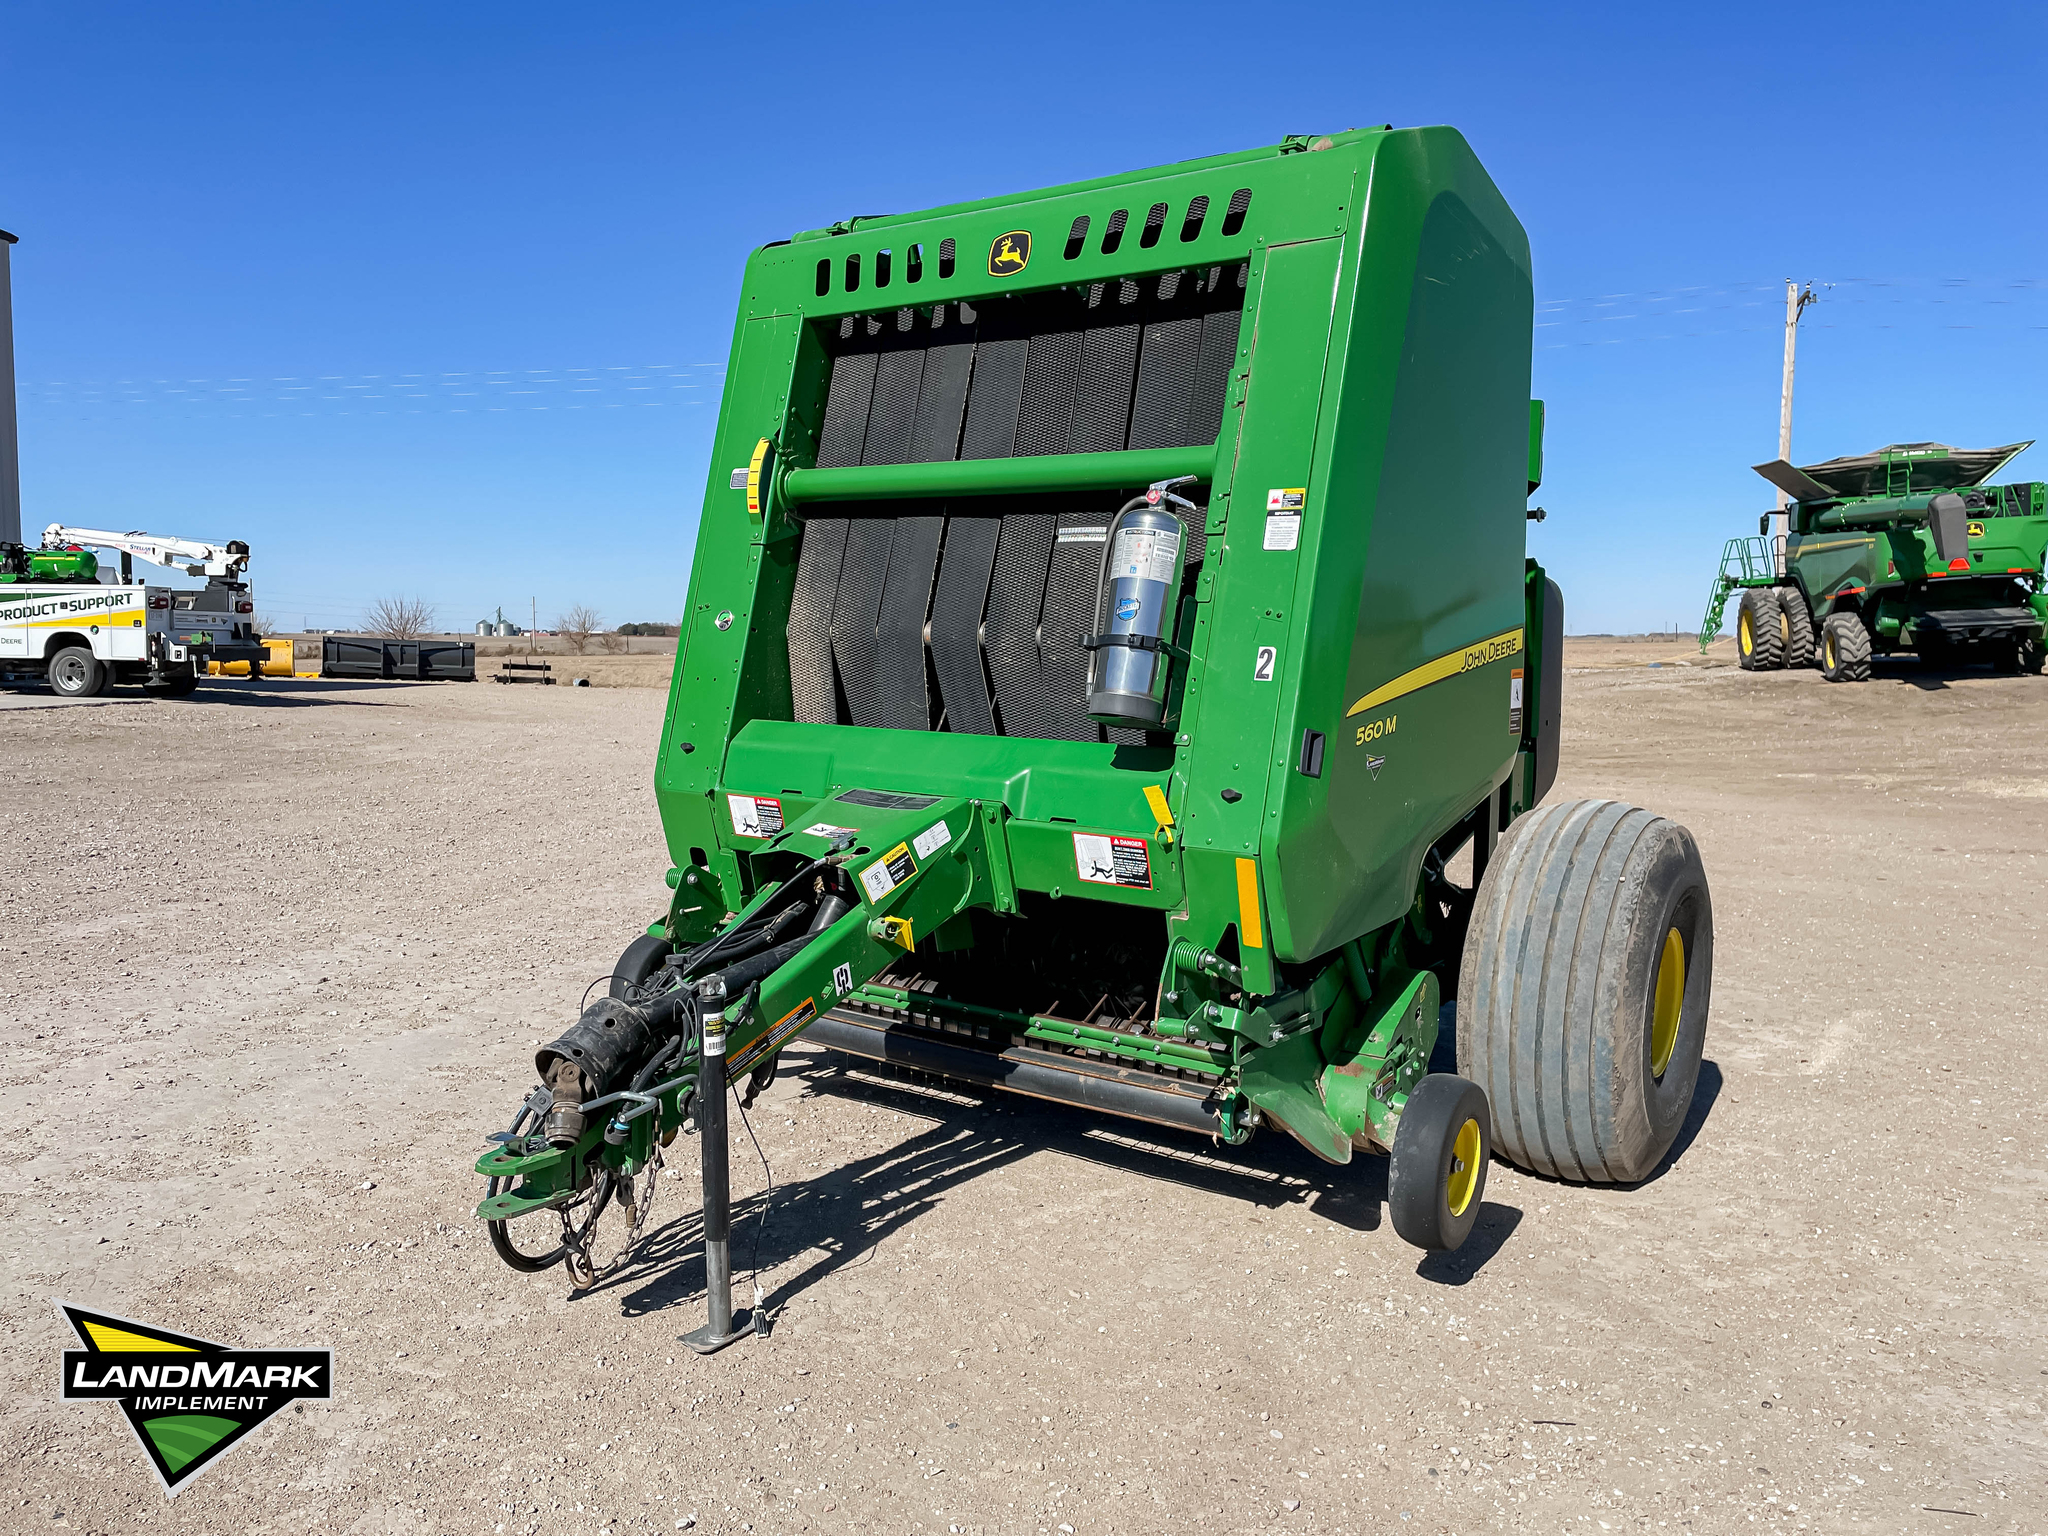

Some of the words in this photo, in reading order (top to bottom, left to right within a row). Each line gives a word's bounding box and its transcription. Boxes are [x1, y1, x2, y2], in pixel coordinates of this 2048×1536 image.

[69, 593, 133, 612] SUPPORT
[1256, 648, 1273, 679] 2
[1460, 650, 1487, 670] JOHN
[1488, 638, 1517, 662] DEERE
[1356, 720, 1384, 746] 560
[1385, 714, 1398, 736] M
[889, 847, 904, 860] CAUTION
